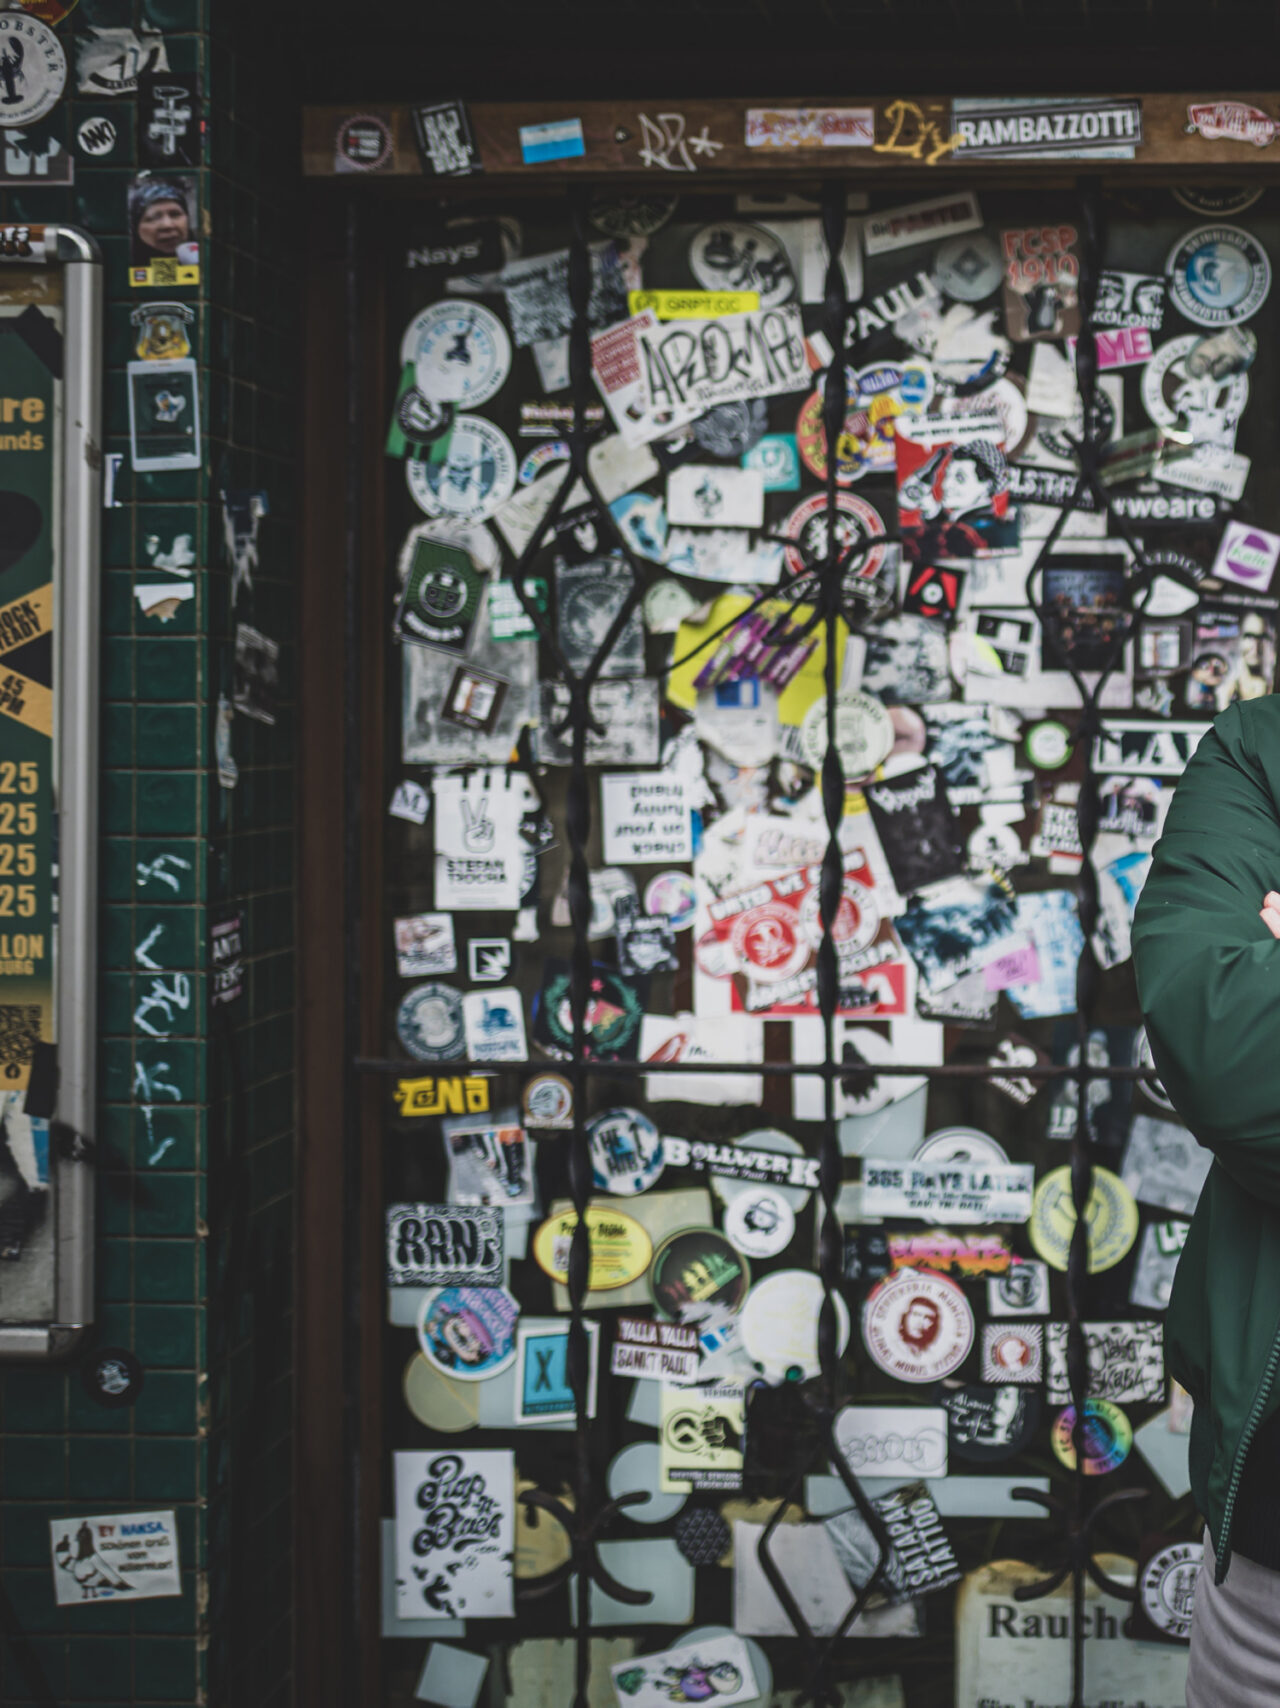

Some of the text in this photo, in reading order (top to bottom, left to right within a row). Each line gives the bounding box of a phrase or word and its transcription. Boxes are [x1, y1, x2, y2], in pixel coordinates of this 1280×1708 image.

[957, 108, 1136, 150] RAMBAZZOTTI
[1004, 224, 1078, 259] FCSP
[0, 761, 39, 795] 25
[0, 802, 38, 836] 25
[633, 803, 684, 816] funny
[615, 822, 685, 837] on your
[0, 843, 37, 877] 25
[0, 884, 37, 917] 25
[909, 1497, 960, 1579] TATTOO
